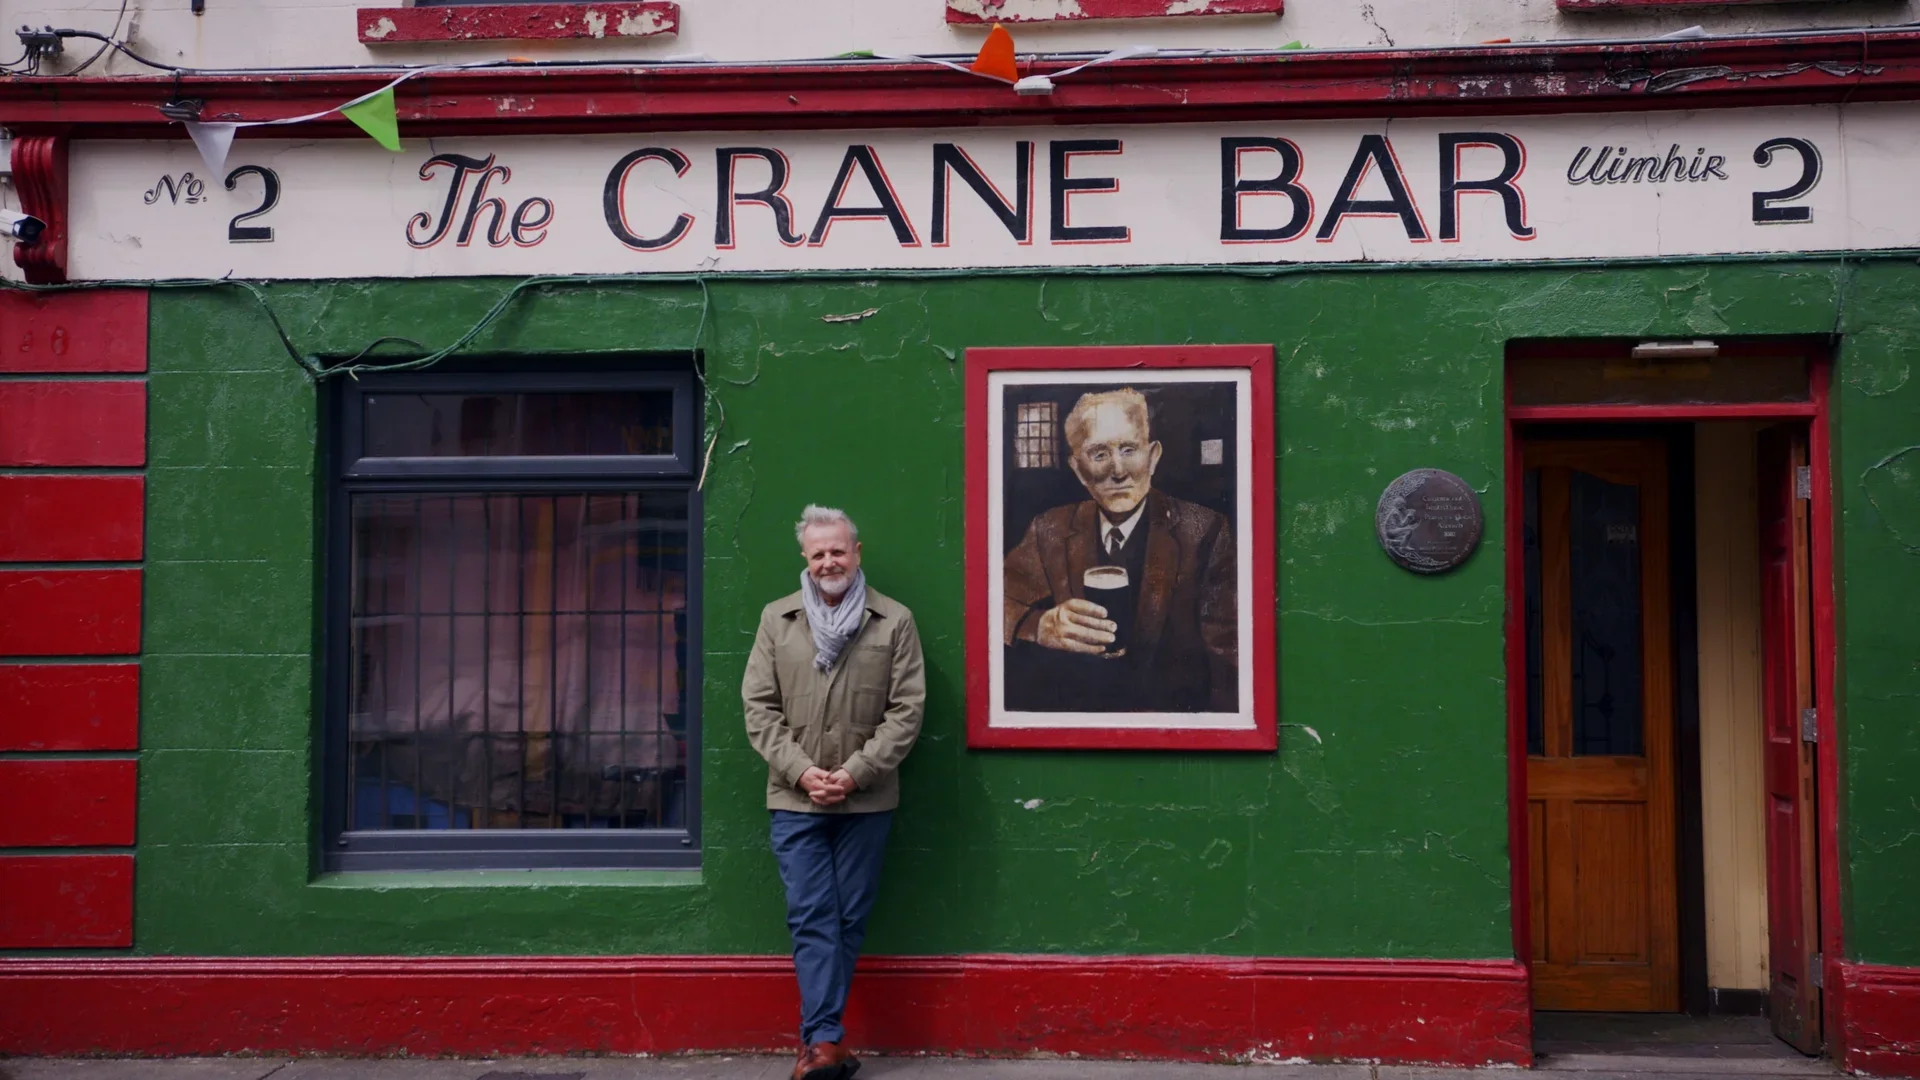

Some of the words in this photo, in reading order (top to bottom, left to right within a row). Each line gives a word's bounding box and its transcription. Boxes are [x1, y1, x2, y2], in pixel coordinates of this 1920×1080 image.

[225, 164, 281, 244] 2
[406, 152, 555, 249] The
[603, 140, 1131, 251] CRANE
[1220, 132, 1537, 244] BAR
[1752, 136, 1823, 225] 2
